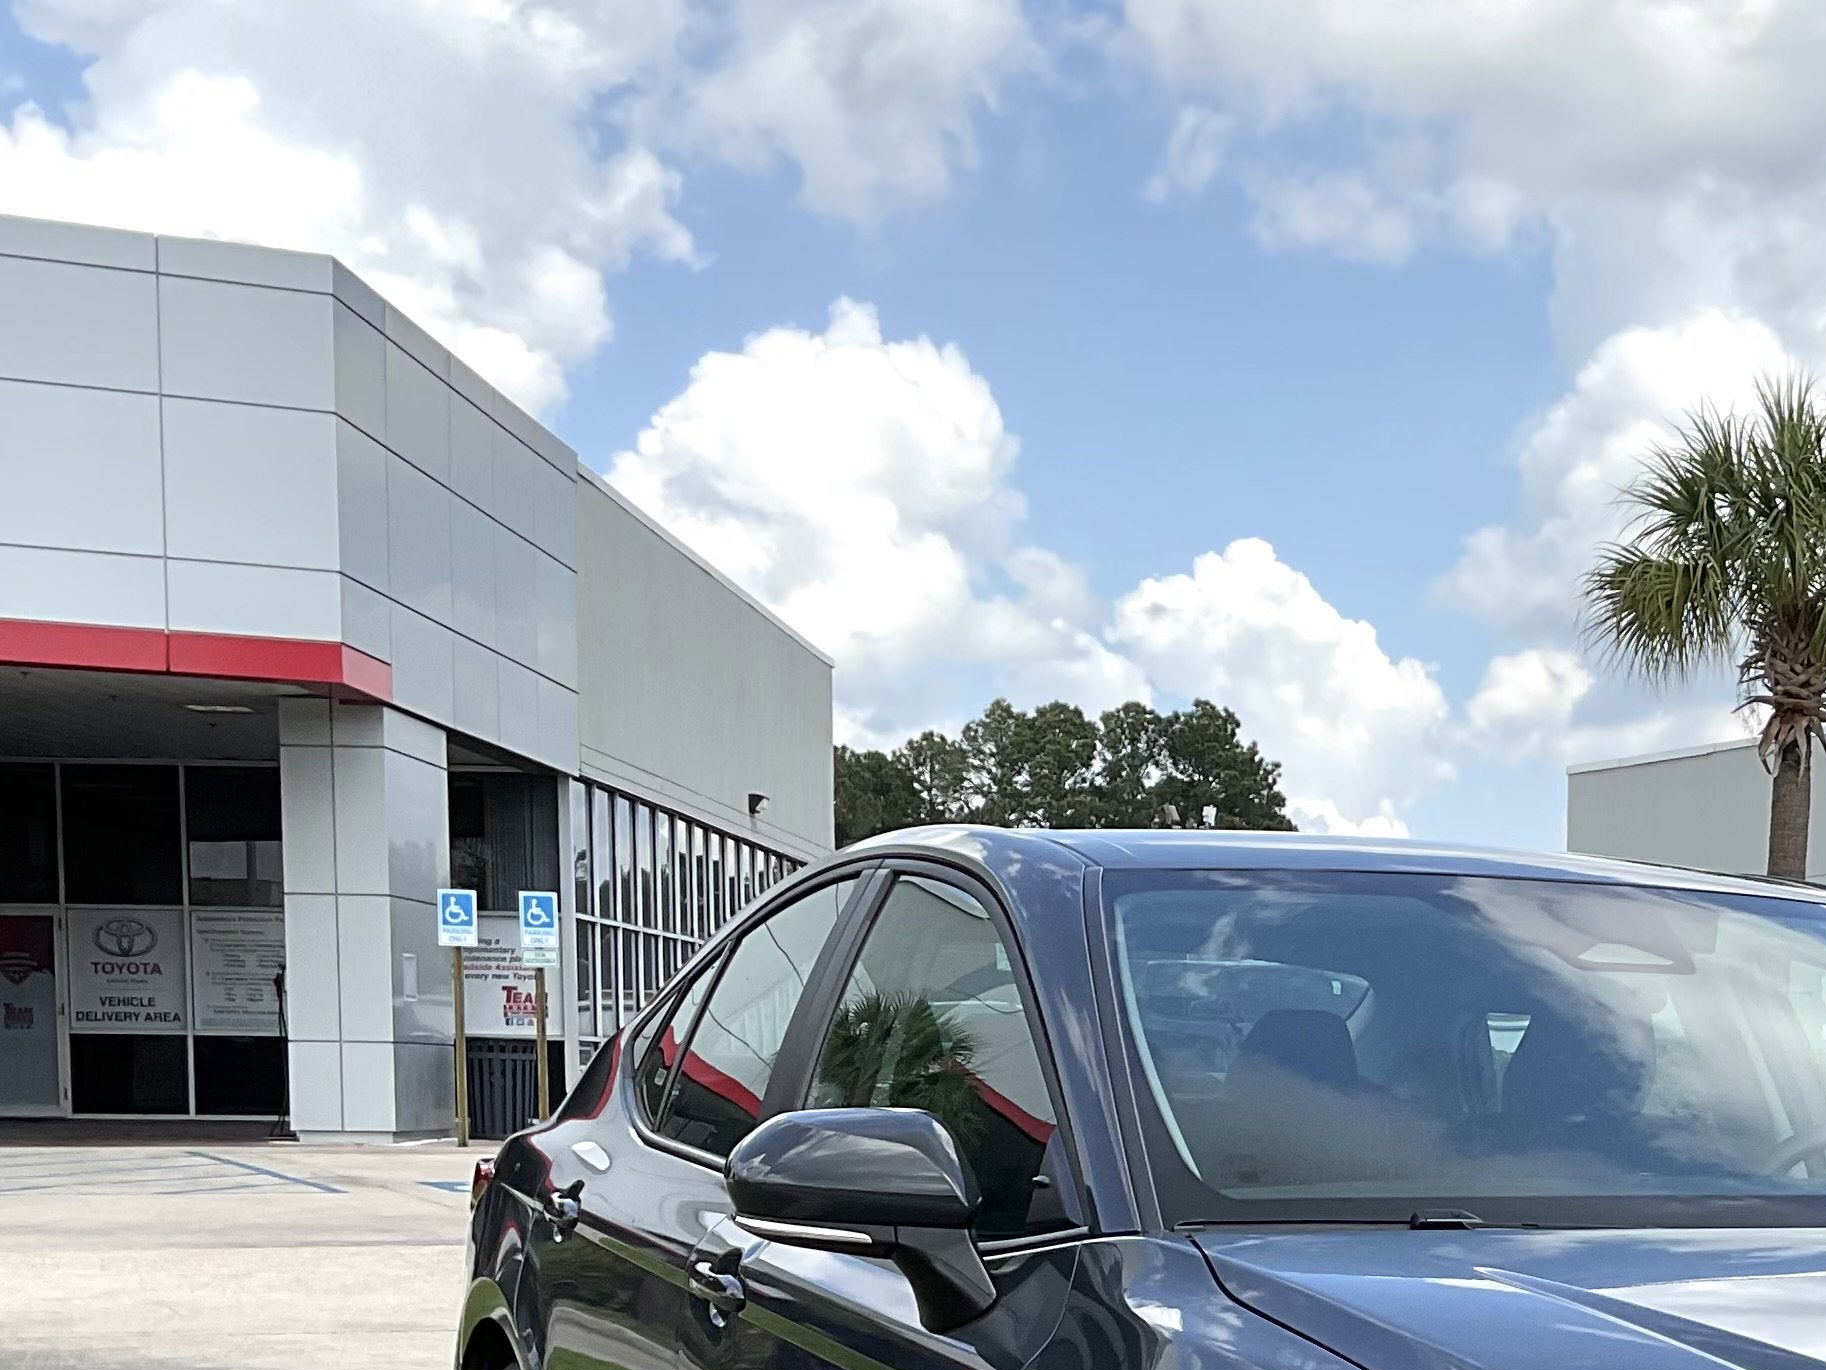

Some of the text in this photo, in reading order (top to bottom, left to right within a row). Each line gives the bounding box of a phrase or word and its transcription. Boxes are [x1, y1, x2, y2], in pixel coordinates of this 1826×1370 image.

[90, 961, 163, 976] TOYOTA
[99, 996, 157, 1008] VEHICLE
[75, 1010, 182, 1023] DELIVERY AREA
